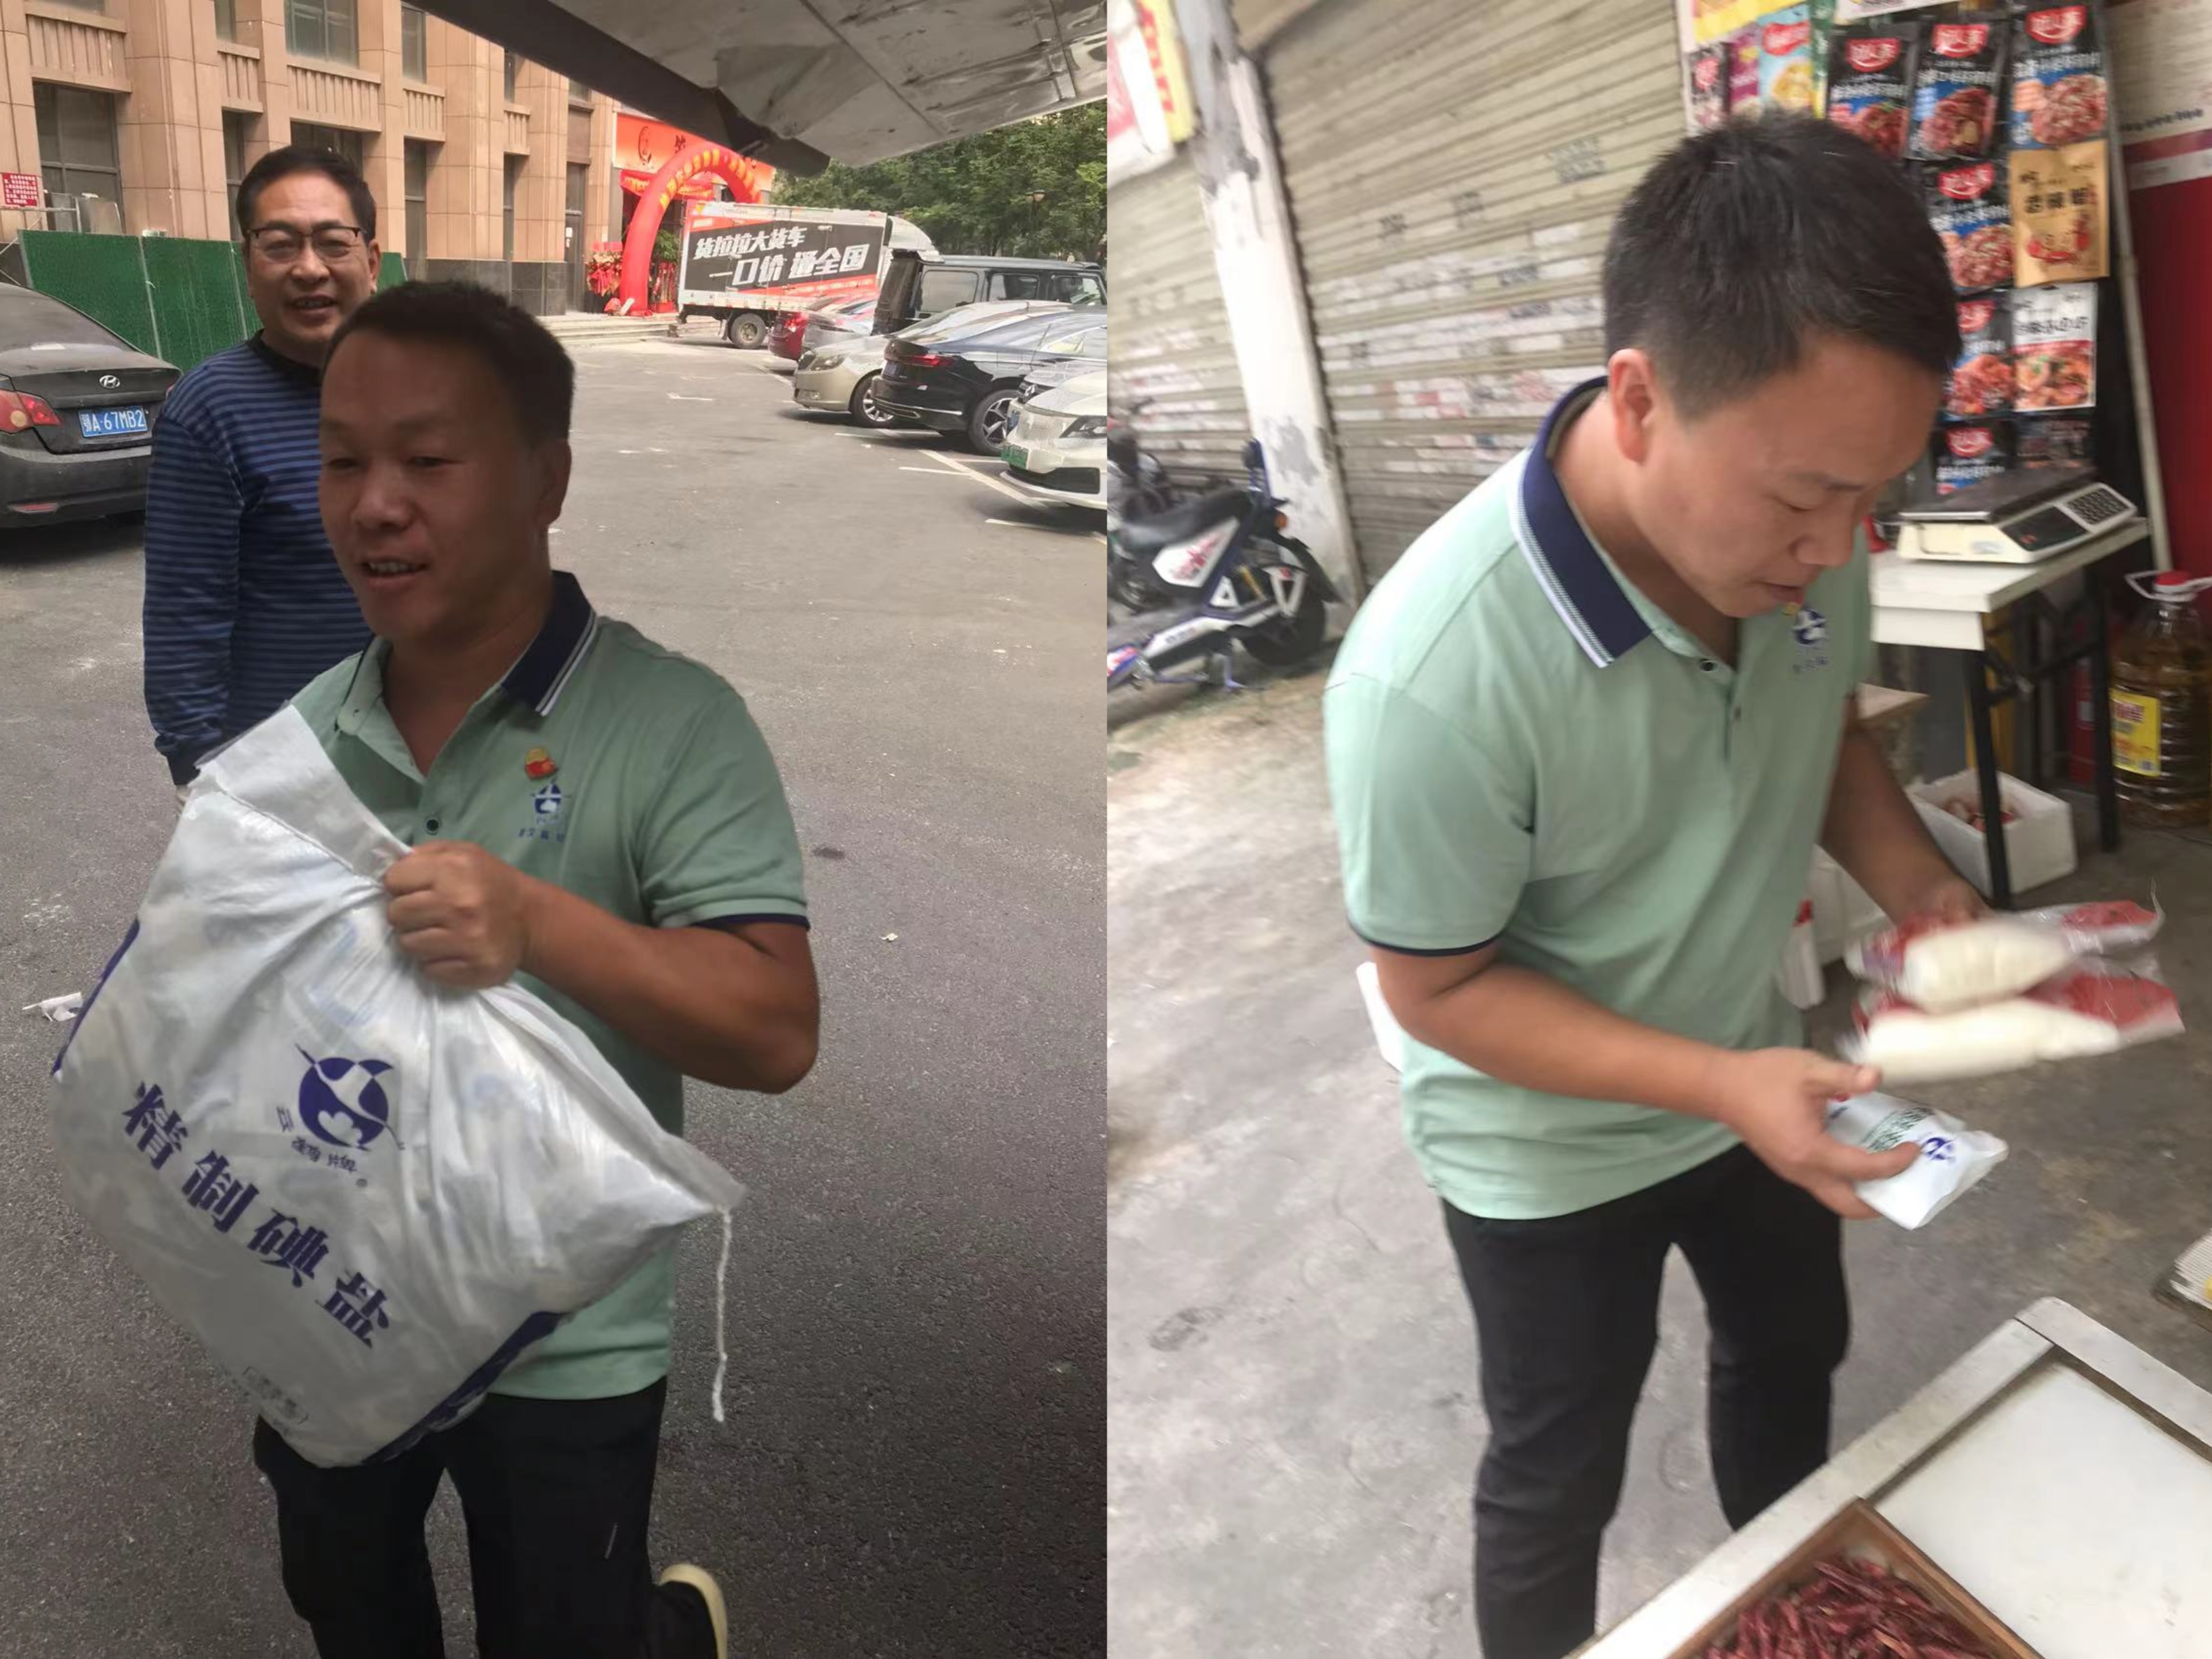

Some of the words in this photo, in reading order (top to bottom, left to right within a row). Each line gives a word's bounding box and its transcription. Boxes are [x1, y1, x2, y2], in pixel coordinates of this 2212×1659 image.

[693, 226, 807, 260] 货拉拉大货车
[709, 253, 787, 286] 一口价
[789, 243, 869, 279] 通全国
[121, 1081, 390, 1348] 精制碘盐
